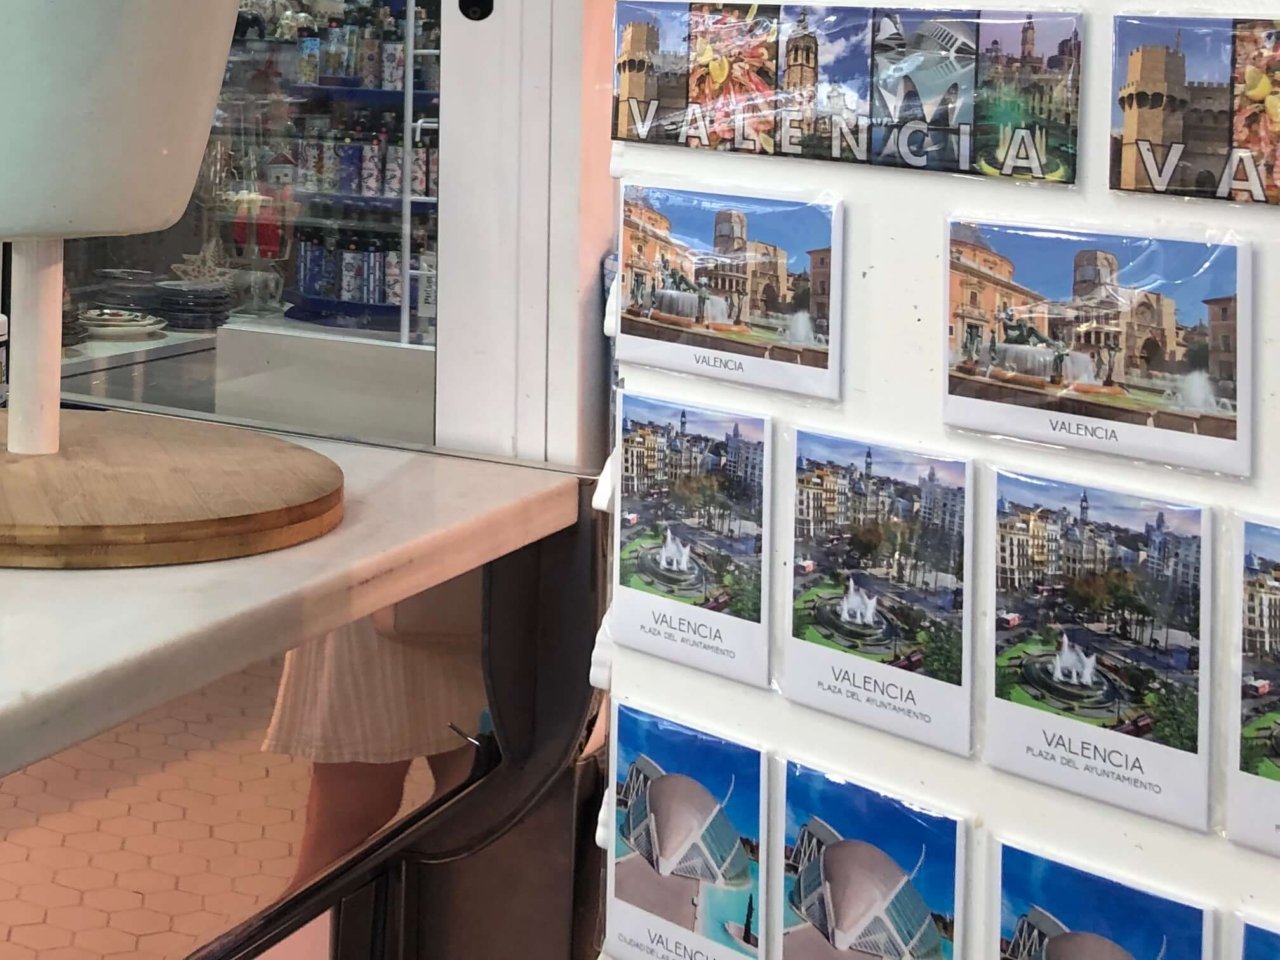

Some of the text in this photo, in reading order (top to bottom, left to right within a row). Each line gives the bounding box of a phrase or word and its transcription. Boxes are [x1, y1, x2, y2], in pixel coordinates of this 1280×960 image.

[627, 97, 1046, 178] VALENCIA
[694, 354, 744, 372] VALENCIA
[1048, 418, 1119, 442] VALENCIA
[640, 624, 736, 659] PLAZA DEL AYUNTAMIENTO
[651, 610, 724, 643] VALENCIA
[817, 680, 932, 723] PLAZA DEL AYUNTAMIENTO
[831, 666, 917, 706] VALENCIA
[1025, 745, 1162, 794] PLAZA DEL AYUNTAMIENTO
[1042, 729, 1145, 775] VALENCIA
[647, 929, 717, 960] VALENC
